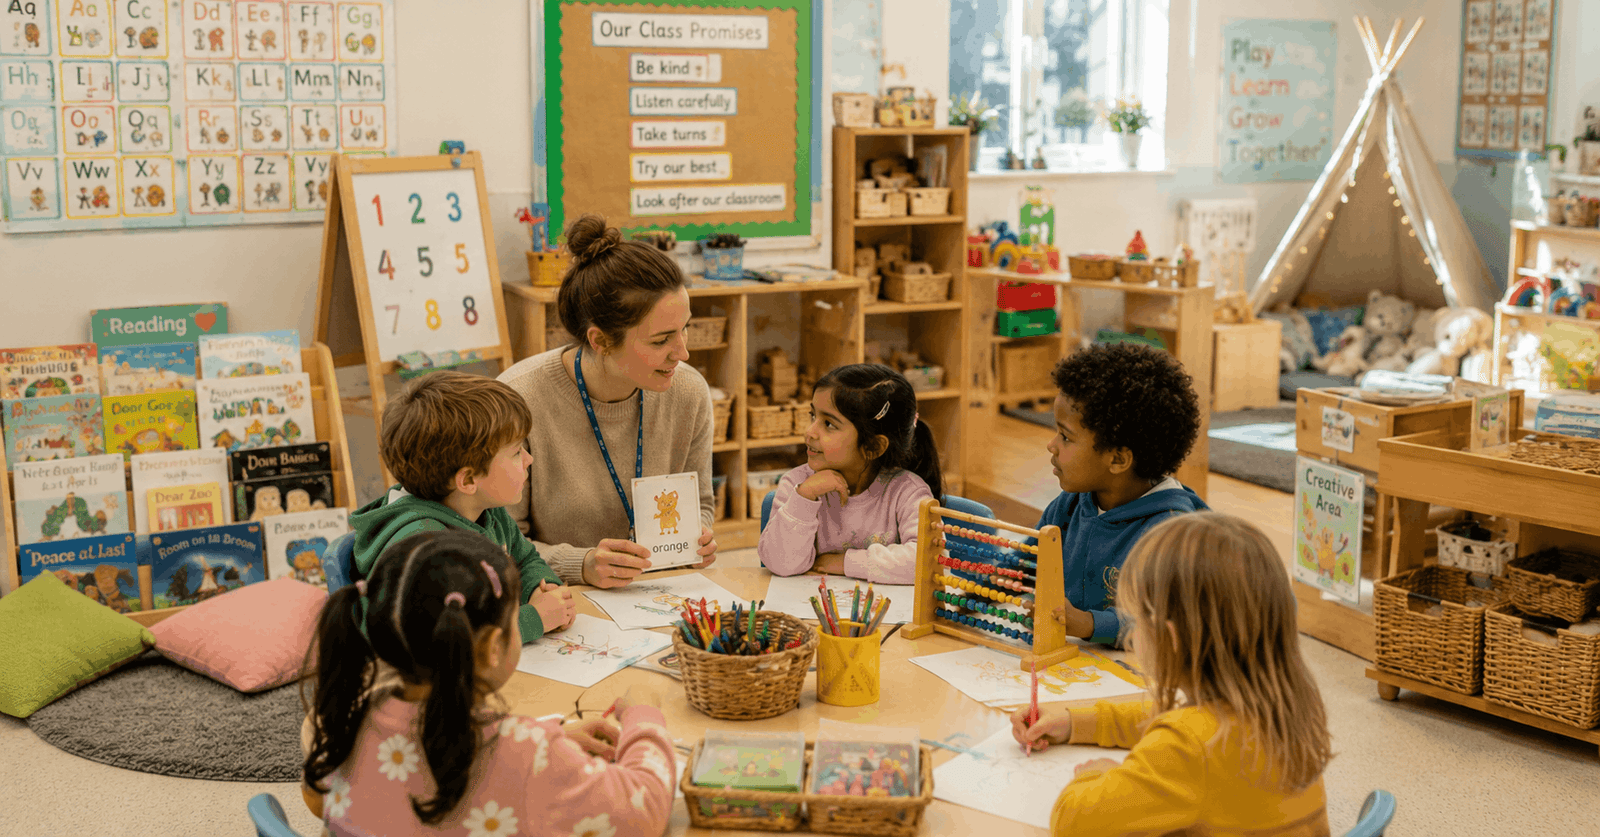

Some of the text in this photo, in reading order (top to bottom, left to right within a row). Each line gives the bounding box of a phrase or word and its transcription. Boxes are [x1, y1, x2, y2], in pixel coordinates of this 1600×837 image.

[127, 0, 151, 19] Cc
[193, 2, 220, 21] Dd
[248, 4, 270, 22] Ee
[301, 6, 319, 26] Ff
[347, 7, 372, 29] Gg
[600, 20, 762, 41] Our Class Promises
[1230, 37, 1276, 69] Play
[8, 65, 38, 85] Hh
[132, 67, 150, 90] Jj
[196, 68, 222, 86] Kk
[295, 69, 330, 86] Mm
[348, 69, 373, 86] Nn
[636, 60, 690, 75] Be kind
[1229, 72, 1291, 97] Learn
[635, 93, 731, 112] Listen carefully
[71, 110, 99, 129] Oo
[128, 110, 158, 130] Qq
[199, 110, 220, 127] Rr
[251, 110, 272, 127] Ss
[302, 109, 320, 126] Tt
[350, 109, 374, 126] Uu
[1228, 105, 1284, 130] Grow
[637, 127, 707, 141] Take turns
[16, 162, 43, 180] Vv
[73, 161, 110, 179] Ww
[135, 160, 160, 178] Xx
[201, 159, 224, 180] Yy
[254, 157, 276, 175] Zz
[637, 160, 717, 178] Try our best
[371, 192, 462, 227] 1 2 3
[637, 192, 783, 210] Look after our classroom
[378, 243, 470, 280] 4 5 5
[109, 315, 187, 338] Reading
[385, 295, 479, 335] 7 8 8
[1306, 468, 1355, 500] Creative
[155, 488, 213, 504] Dear Zoo
[1316, 494, 1342, 518] Area
[31, 550, 76, 567] Peace
[652, 540, 689, 554] orange
